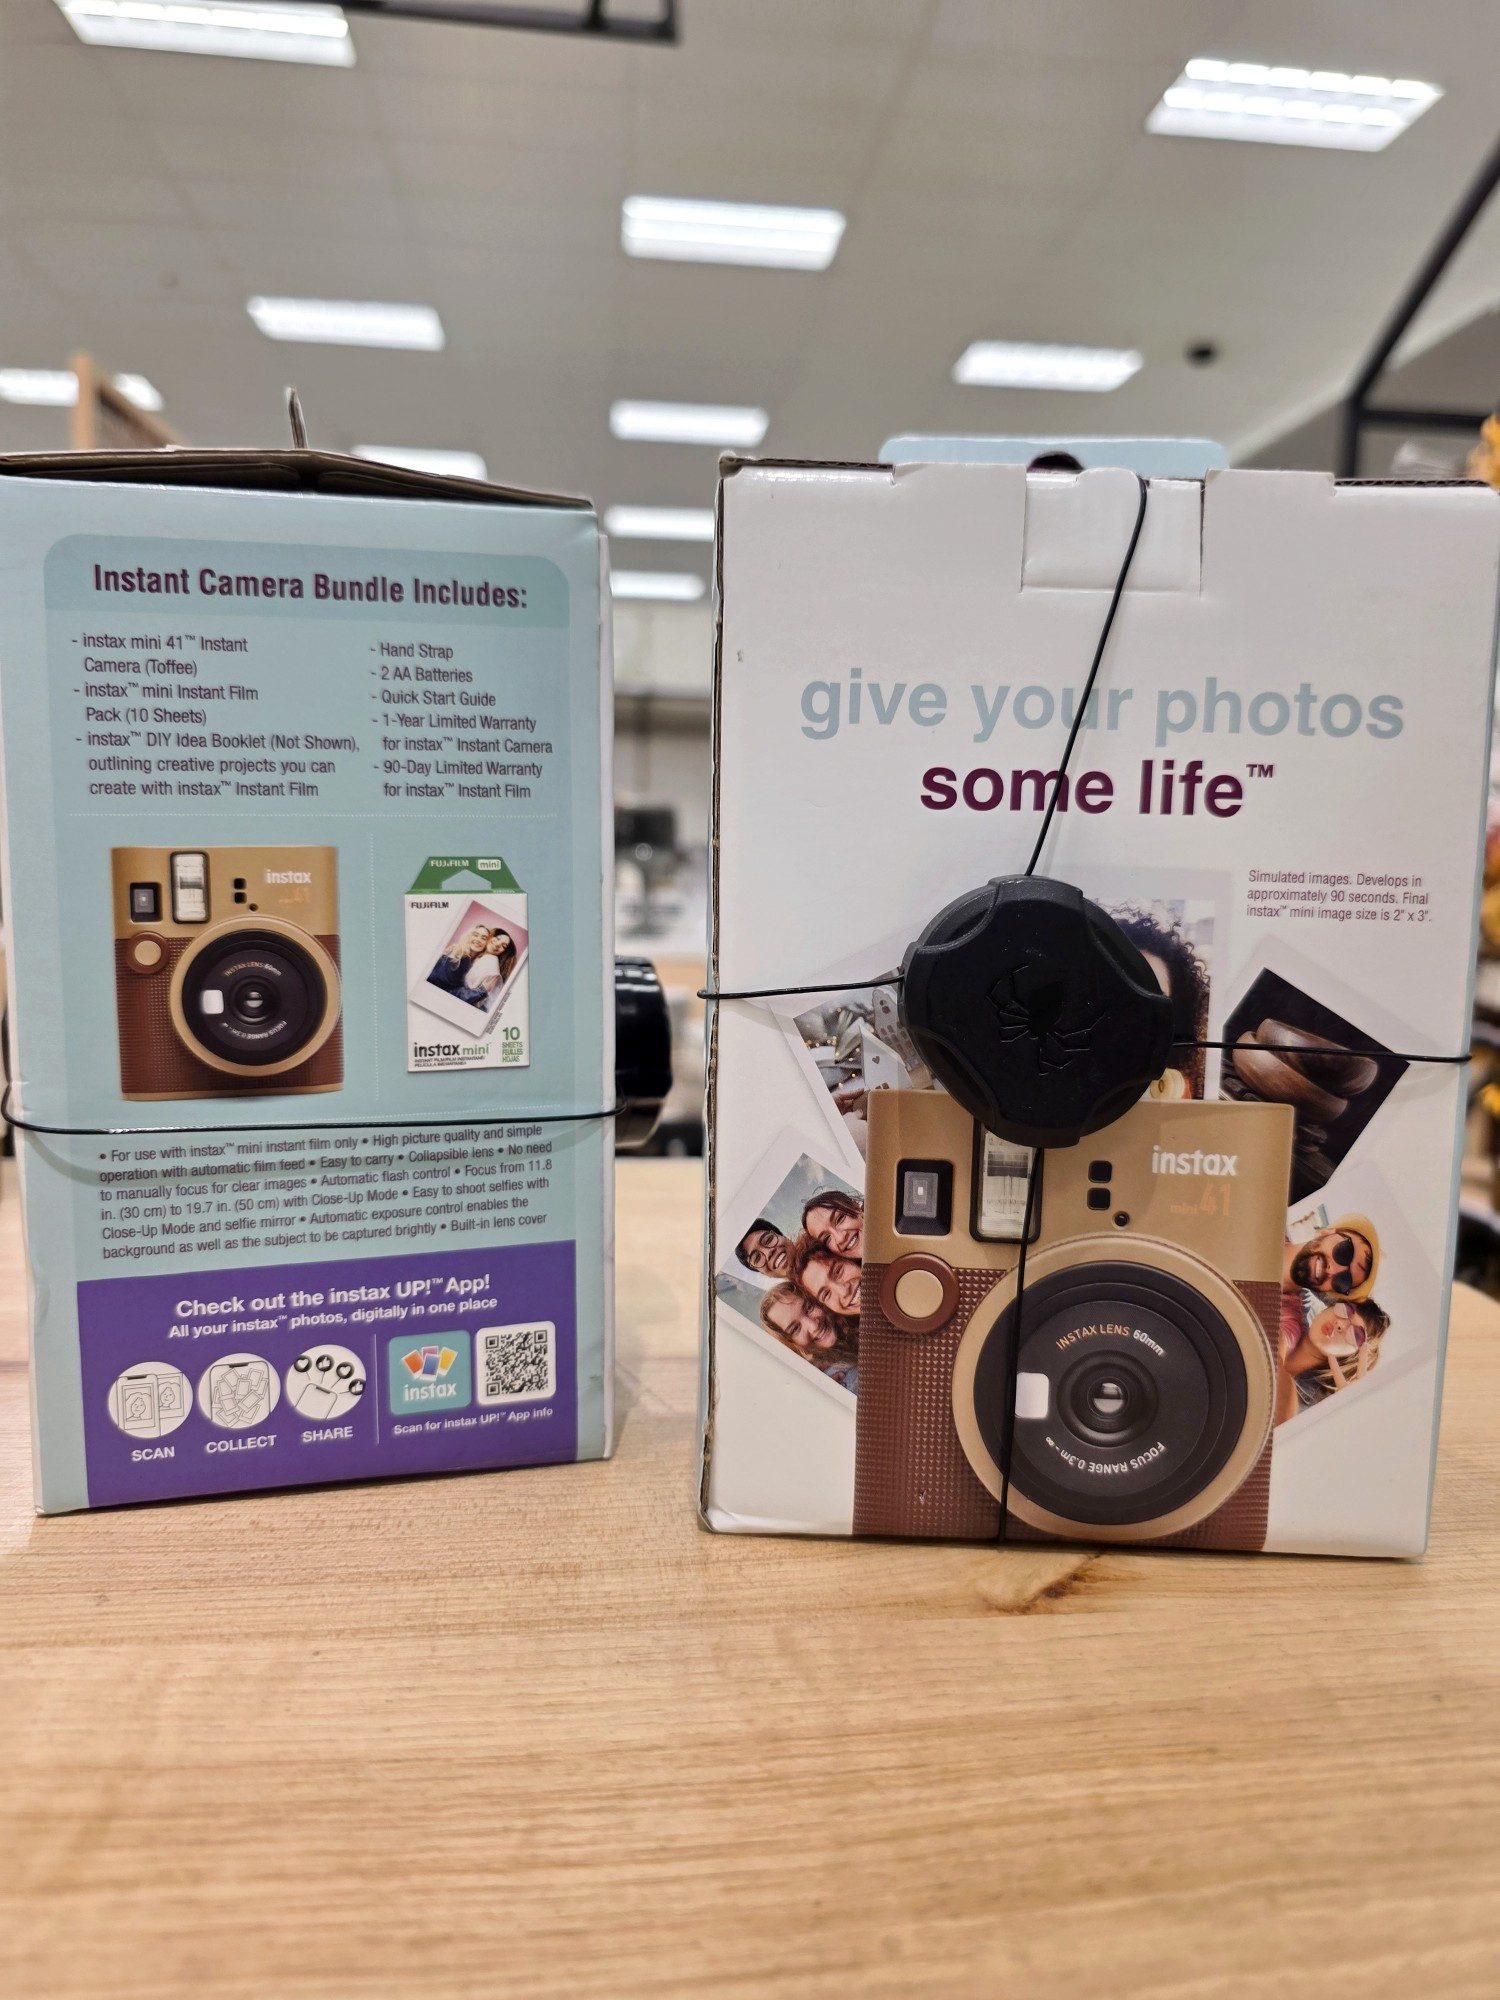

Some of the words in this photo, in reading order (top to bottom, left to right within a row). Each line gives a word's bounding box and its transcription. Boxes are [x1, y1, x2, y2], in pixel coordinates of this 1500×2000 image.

[94, 564, 190, 594] Instant
[199, 568, 303, 598] Camera
[314, 573, 403, 602] Bundle
[414, 578, 526, 608] Includes:
[83, 632, 126, 648] instax
[130, 634, 161, 649] mini
[166, 634, 195, 649] 41™
[200, 636, 248, 652] Instant
[380, 642, 414, 657] Hand
[418, 643, 453, 661] Strap
[84, 656, 141, 673] Camera
[145, 658, 197, 677] (Toffee)
[381, 665, 389, 680] 2
[393, 666, 411, 680] AA
[415, 666, 472, 682] Batteries
[85, 681, 138, 697] instax™
[142, 683, 172, 698] mini
[177, 684, 225, 699] Instant
[229, 685, 258, 700] Film
[381, 689, 419, 704] Quick
[422, 689, 456, 705] Start
[459, 691, 496, 706] Guide
[86, 706, 121, 721] Pack
[125, 707, 148, 724] (10
[153, 707, 206, 726] Sheets)
[800, 668, 948, 741] give
[970, 675, 1133, 744] your
[1155, 677, 1403, 746] photos
[382, 712, 424, 727] 1-Year
[429, 713, 476, 729] Limited
[480, 715, 536, 732] Warranty
[88, 730, 141, 746] instax™
[146, 731, 171, 746] DIY
[176, 732, 207, 747] Idea
[211, 733, 266, 748] Booklet
[270, 734, 300, 751] (Not
[303, 734, 361, 751] Shown),
[382, 736, 401, 750] for
[404, 736, 452, 751] instax™
[457, 737, 500, 752] Instant
[504, 738, 552, 753] Camera
[88, 755, 151, 774] outlining
[156, 757, 214, 771] creative
[219, 757, 276, 775] projects
[280, 761, 305, 775] you
[310, 761, 335, 773] can
[383, 760, 431, 776] 90-Day
[435, 760, 482, 774] Limited
[486, 761, 542, 778] Warranty
[89, 780, 136, 794] create
[140, 780, 172, 795] with
[177, 780, 231, 795] instax™
[236, 781, 285, 796] Instant
[289, 781, 318, 796] Film
[383, 782, 401, 796] for
[405, 782, 454, 797] instax™
[458, 783, 501, 797] Instant
[505, 784, 530, 798] Film
[920, 766, 1115, 815] some
[1138, 760, 1275, 819] life™
[266, 868, 312, 884] instax
[1249, 870, 1304, 883] Simulated
[1309, 872, 1351, 887] images.
[1356, 874, 1408, 889] Develops
[1412, 875, 1422, 887] in
[1248, 889, 1327, 904] approximately
[1331, 890, 1345, 902] 90
[1348, 891, 1398, 904] seconds.
[1403, 892, 1428, 904] Final
[1246, 904, 1287, 917] instax™
[1289, 906, 1314, 917] mini
[1318, 906, 1351, 921] image
[1355, 908, 1376, 920] size
[1380, 908, 1390, 920] is
[1393, 908, 1404, 921] 2"
[1407, 912, 1414, 921] x
[1417, 909, 1431, 921] 3".
[502, 1026, 520, 1040] 10
[414, 1042, 460, 1058] instax
[111, 1149, 131, 1161] For
[134, 1150, 156, 1160] use
[159, 1146, 186, 1158] with
[189, 1142, 234, 1156] instax™
[236, 1141, 262, 1154] mini
[266, 1139, 305, 1152] instant
[308, 1138, 330, 1149] film
[334, 1136, 358, 1150] only
[372, 1134, 398, 1148] High
[401, 1132, 440, 1146] picture
[443, 1128, 480, 1143] quality
[483, 1126, 503, 1139] and
[506, 1124, 542, 1138] simple
[1152, 1144, 1238, 1176] instax
[1170, 1203, 1198, 1214] mini
[1200, 1184, 1231, 1216] 41
[102, 1241, 175, 1259] background
[178, 1242, 193, 1252] as
[196, 1238, 221, 1251] well
[224, 1239, 238, 1249] as
[241, 1236, 261, 1247] the
[264, 1232, 306, 1247] subject
[308, 1231, 321, 1242] to
[324, 1230, 338, 1241] be
[341, 1225, 391, 1241] captured
[395, 1222, 436, 1237] brightly
[450, 1217, 489, 1231] Built-in
[493, 1216, 515, 1227] lens
[518, 1214, 547, 1225] cover
[175, 1296, 245, 1317] Check
[249, 1293, 285, 1311] out
[289, 1290, 324, 1307] the
[329, 1286, 390, 1303] instax
[396, 1277, 443, 1298] UP!™
[444, 1273, 489, 1295] App!
[168, 1324, 189, 1338] All
[192, 1323, 228, 1338] your
[231, 1314, 287, 1332] instax™
[289, 1312, 347, 1329] photos,
[350, 1304, 408, 1322] digitally
[411, 1303, 424, 1315] in
[427, 1302, 455, 1314] one
[458, 1298, 497, 1313] place
[1055, 1324, 1097, 1350] INSTAX
[1100, 1324, 1130, 1336] LENS
[1132, 1328, 1165, 1357] 60mm
[404, 1382, 457, 1402] instax
[393, 1424, 422, 1434] Scan
[424, 1420, 441, 1430] for
[443, 1417, 477, 1428] instax
[507, 1411, 530, 1421] App
[533, 1407, 552, 1417] info
[205, 1434, 277, 1453] COLLECT
[302, 1426, 354, 1442] SHARE
[132, 1446, 176, 1462] SCAN
[1060, 1450, 1085, 1470] 0.3m
[1130, 1442, 1166, 1469] FOCUS
[1088, 1462, 1128, 1474] RANGE
